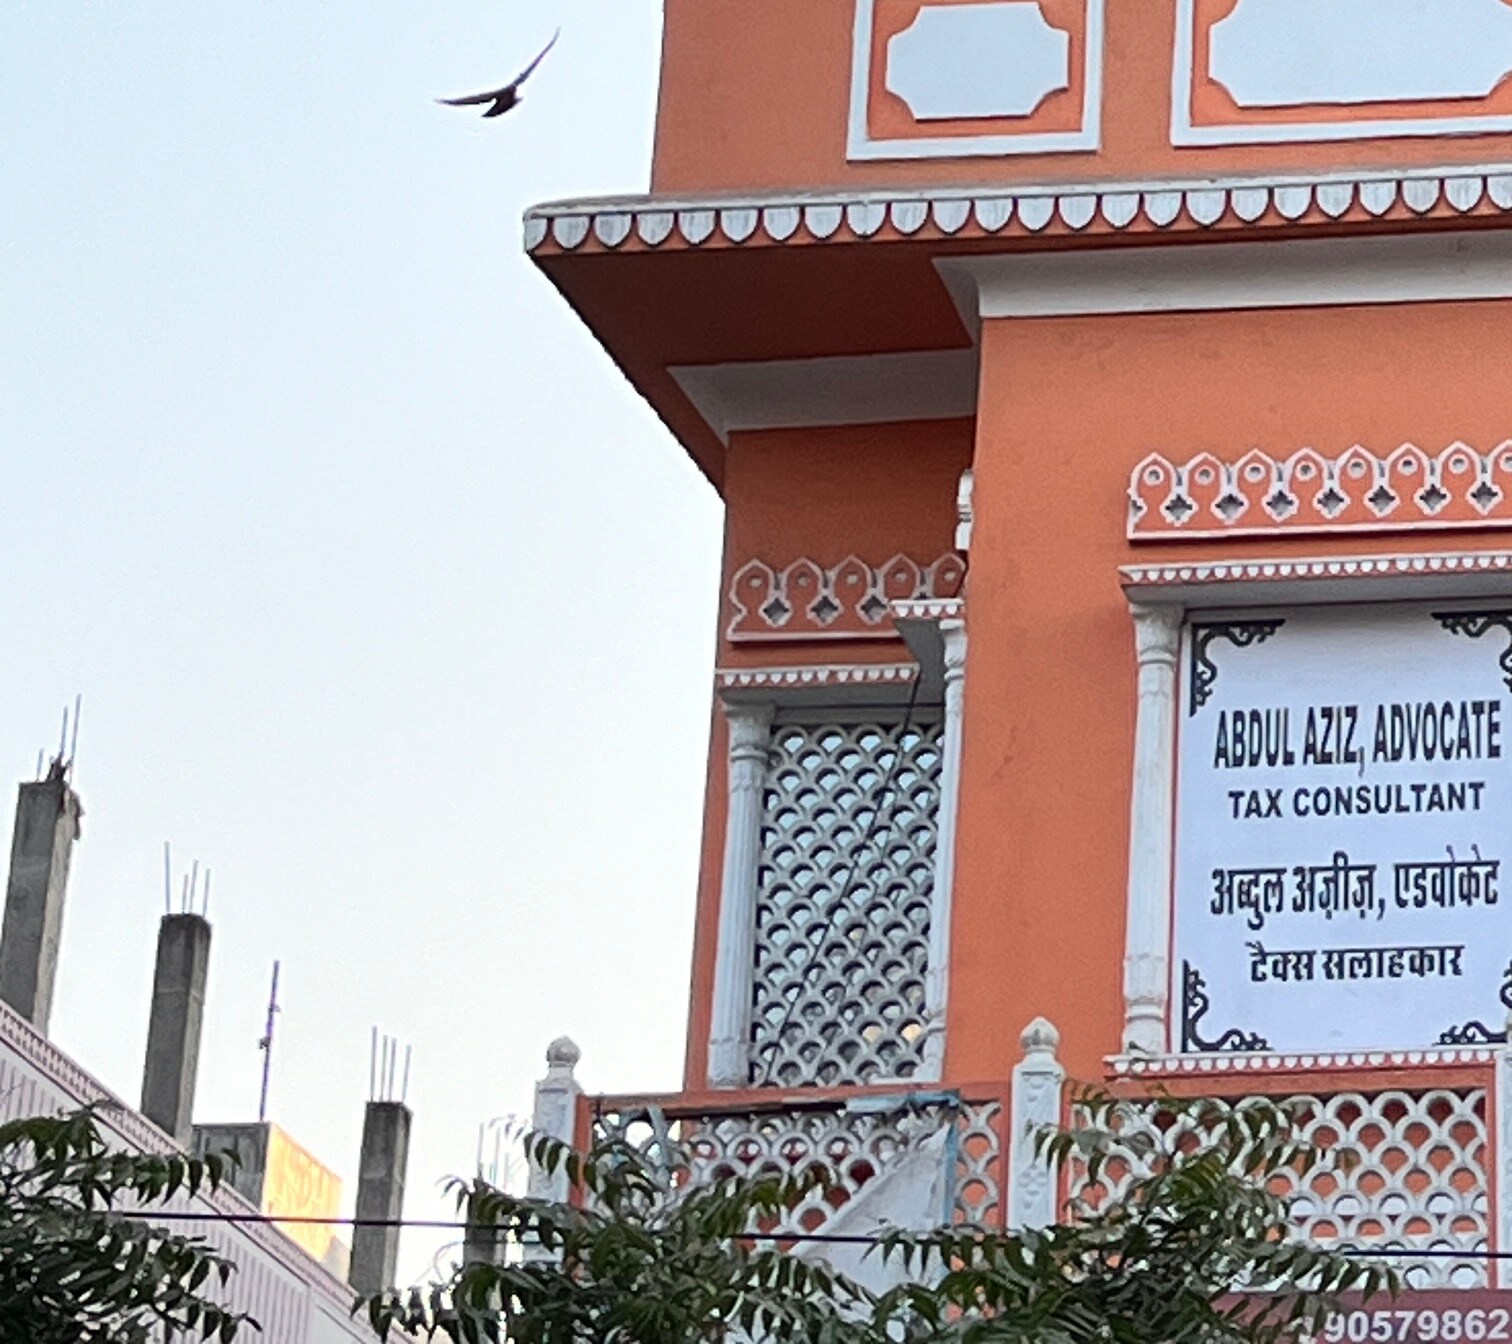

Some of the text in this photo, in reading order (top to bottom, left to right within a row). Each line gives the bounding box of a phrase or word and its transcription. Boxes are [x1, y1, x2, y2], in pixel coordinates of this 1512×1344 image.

[1213, 699, 1502, 778] ABDUL AZIZ, ADVOCATE
[1228, 781, 1486, 819] TAX CONSULTANT
[1210, 867, 1287, 930] अब्दुल
[1393, 843, 1500, 909] एडवोकेट
[1245, 940, 1465, 982] टैक्स सलाहकार
